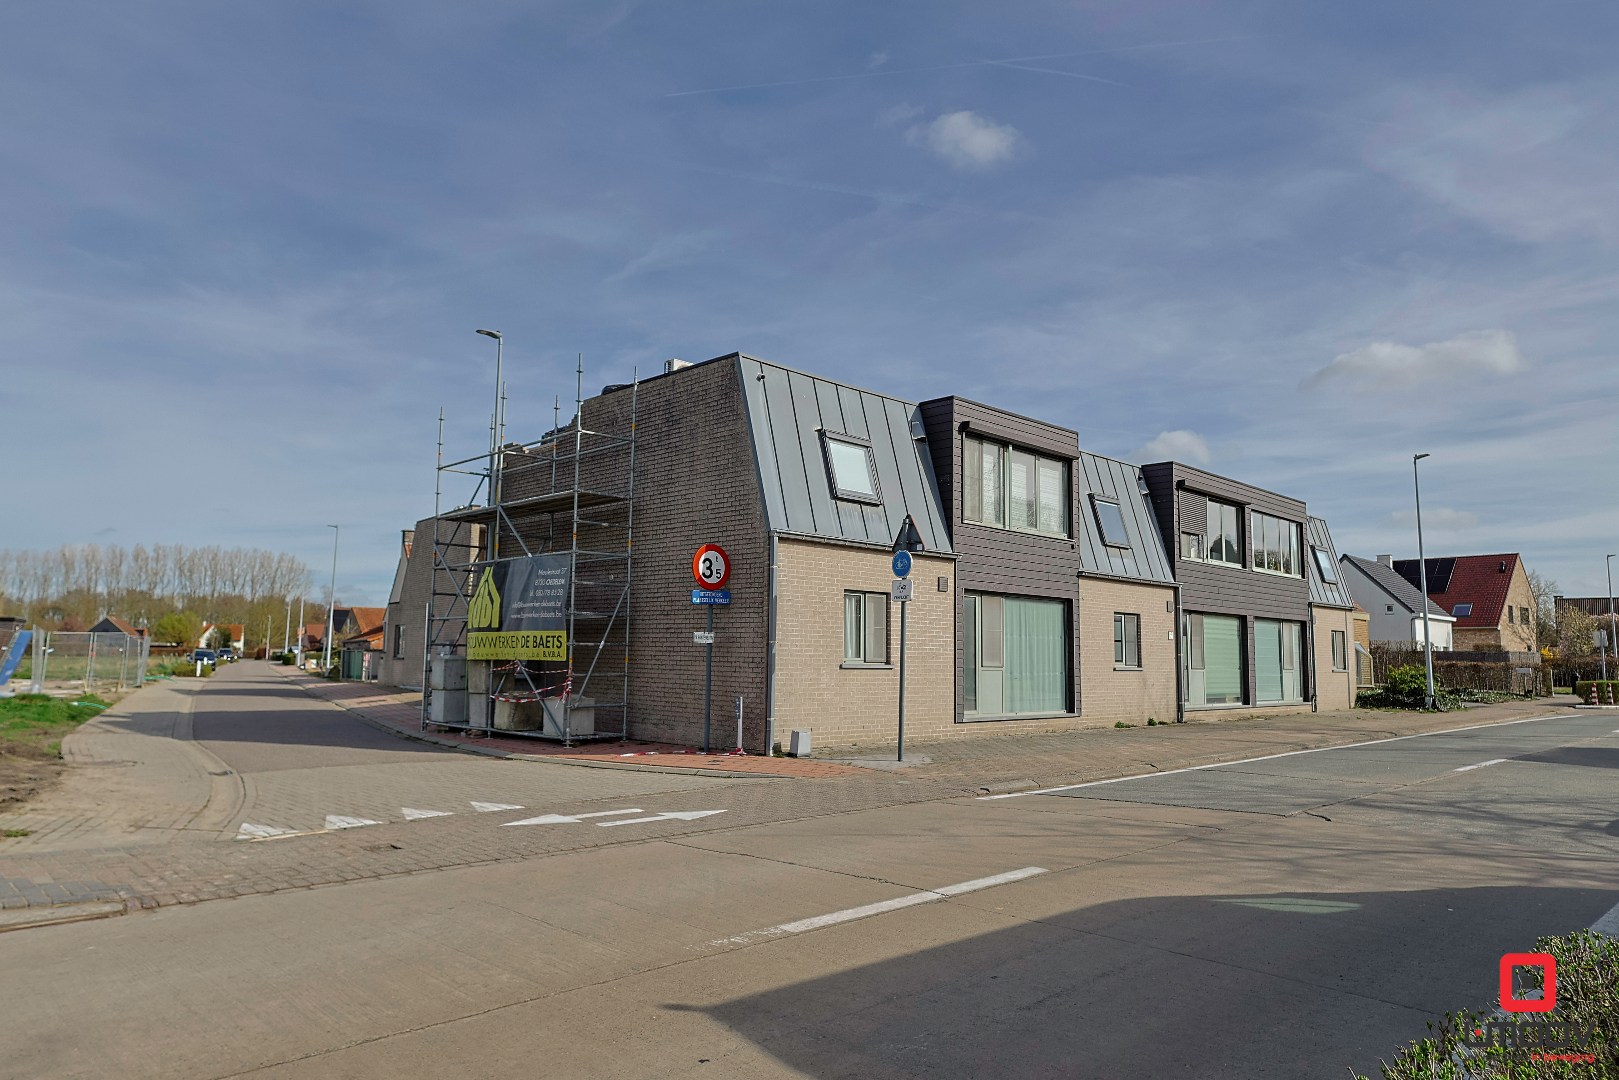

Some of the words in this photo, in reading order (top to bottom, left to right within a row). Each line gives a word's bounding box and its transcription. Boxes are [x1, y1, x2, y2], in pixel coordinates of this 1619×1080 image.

[702, 557, 714, 579] 3
[716, 569, 722, 579] 5
[521, 635, 530, 649] DE
[532, 635, 563, 649] BAETS
